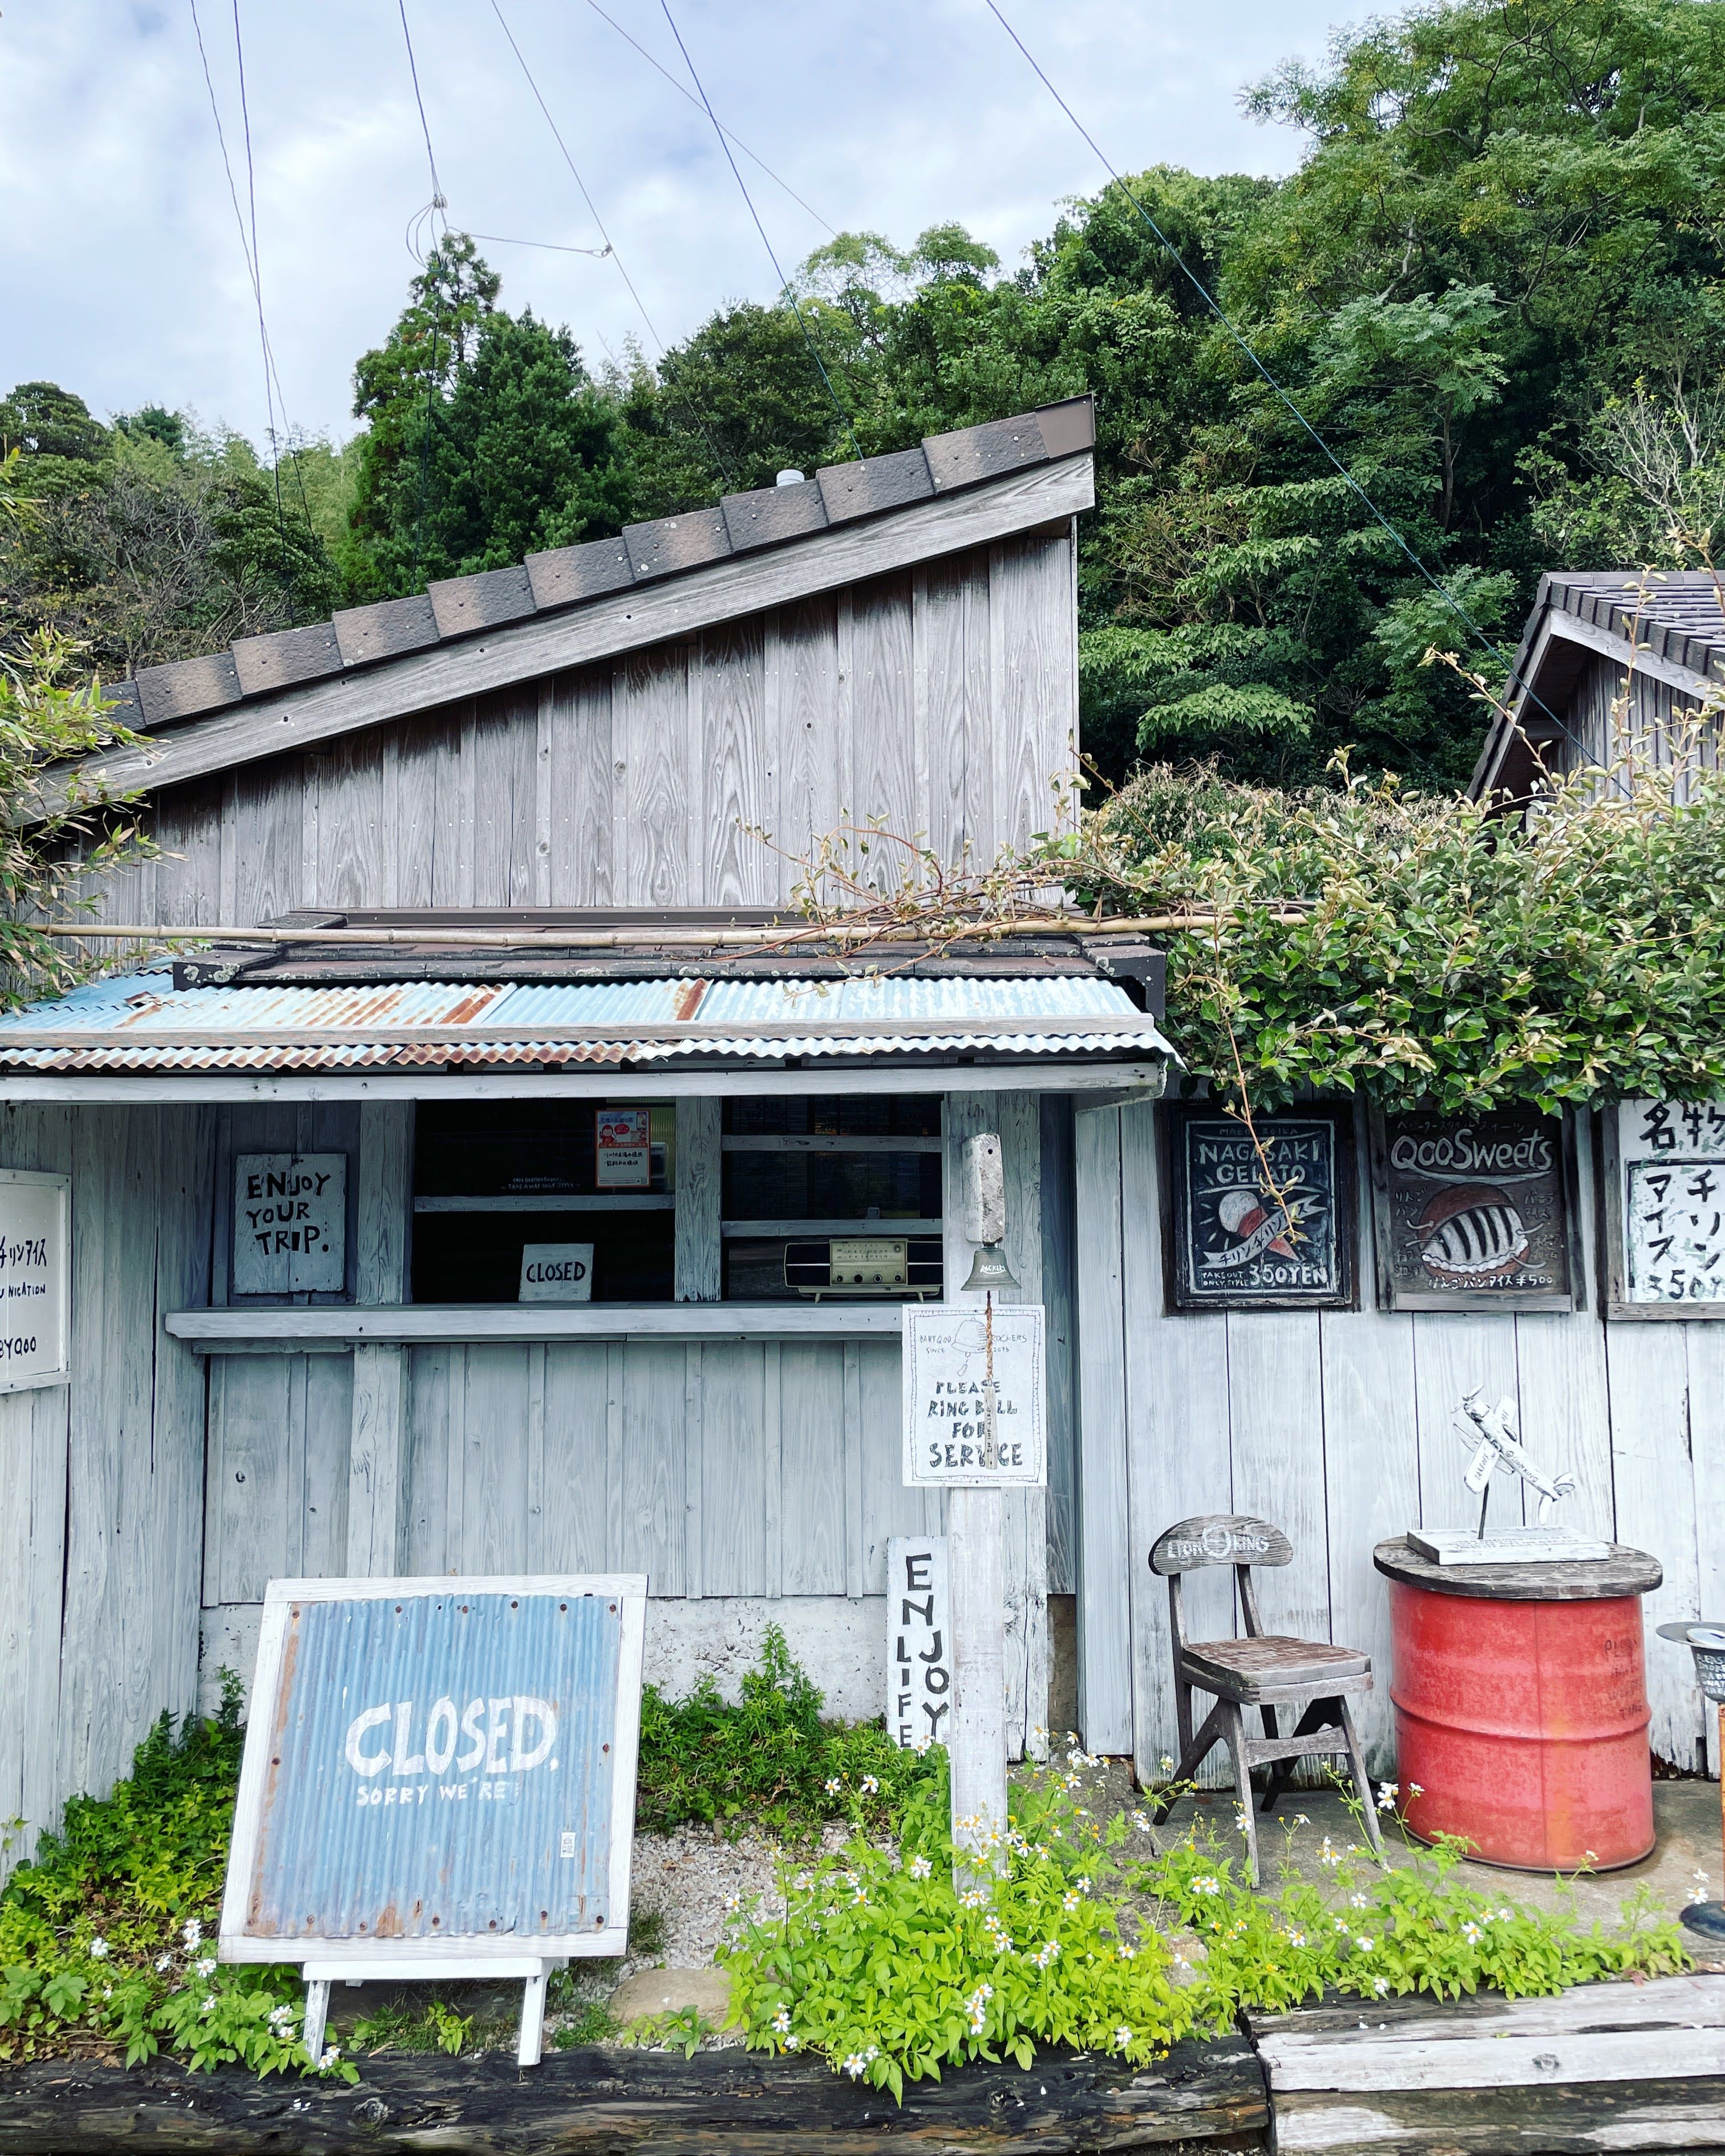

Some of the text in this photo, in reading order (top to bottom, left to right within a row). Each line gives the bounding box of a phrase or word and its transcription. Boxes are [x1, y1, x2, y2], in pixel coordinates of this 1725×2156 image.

[1199, 1140, 1319, 1164] NAGASAKI
[248, 1172, 331, 1199] ENJOY
[1216, 1164, 1306, 1184] GELATO
[246, 1201, 310, 1229] YOUR
[255, 1226, 329, 1255] TRIP.
[526, 1262, 586, 1283] CLOSED
[927, 1400, 1018, 1419] RING BLL
[903, 1553, 949, 1737] ENJOY
[897, 1636, 912, 1748] LIFE
[356, 1784, 429, 1807] SORRY
